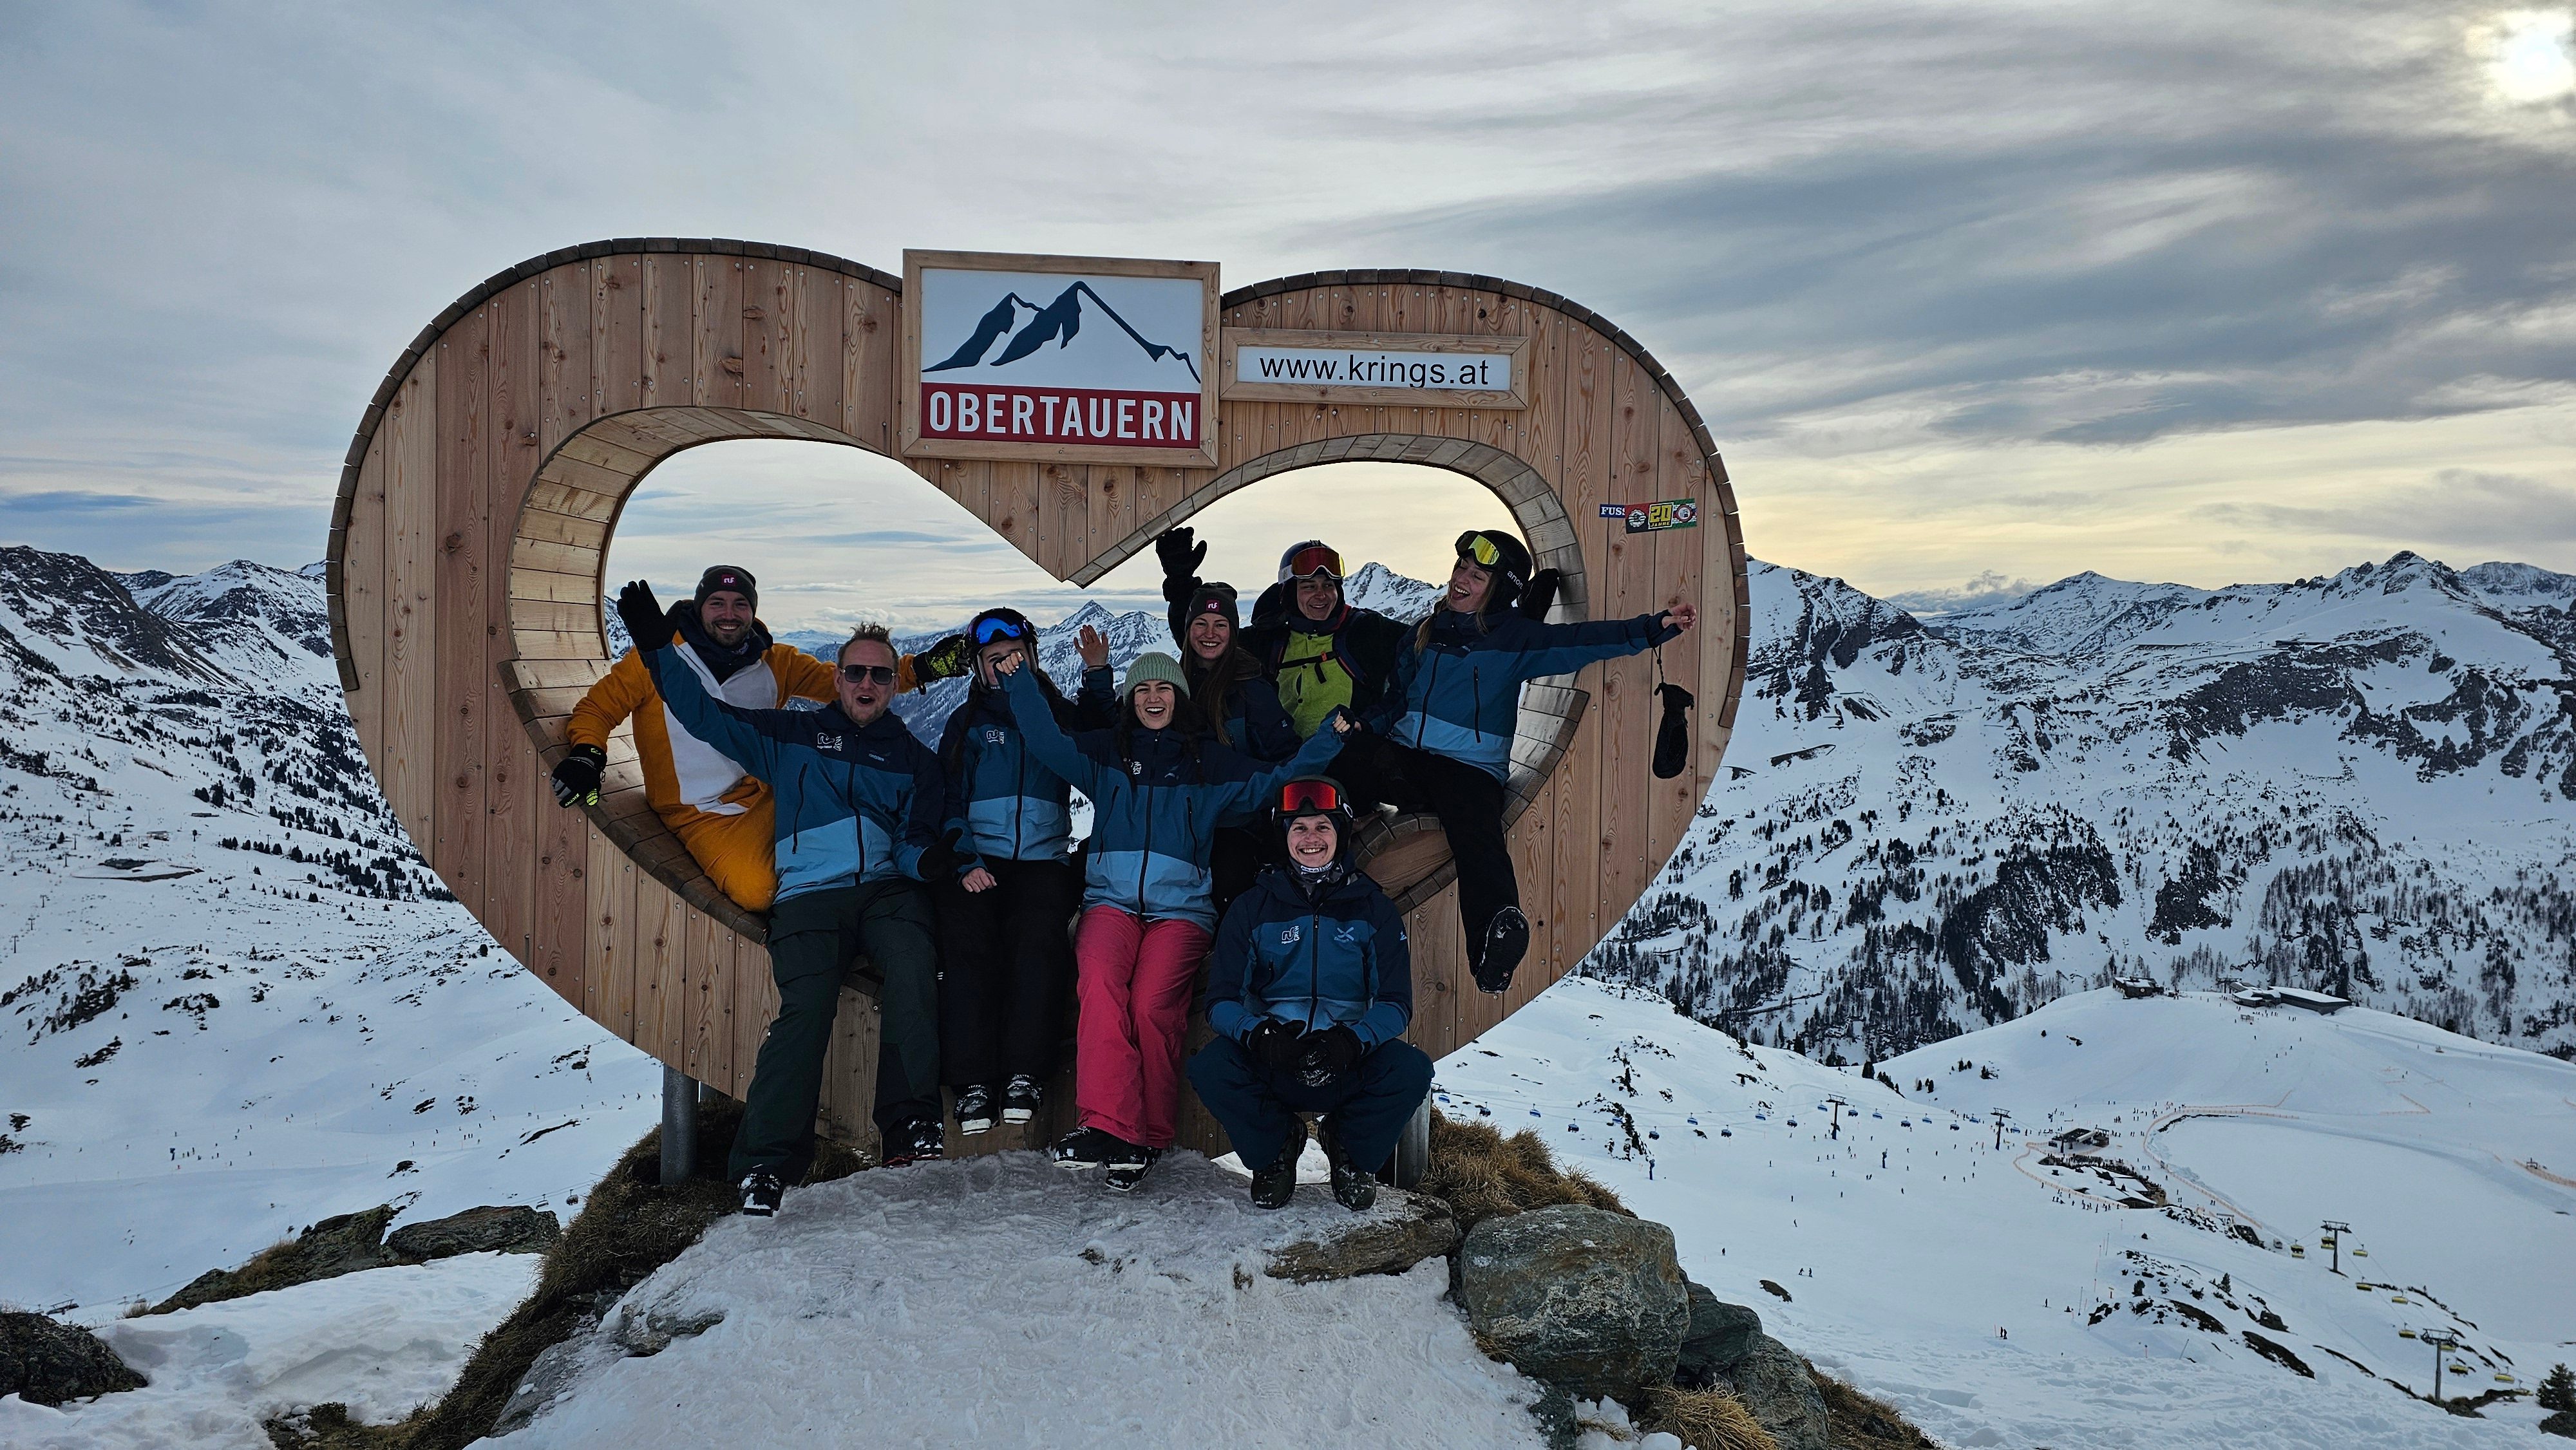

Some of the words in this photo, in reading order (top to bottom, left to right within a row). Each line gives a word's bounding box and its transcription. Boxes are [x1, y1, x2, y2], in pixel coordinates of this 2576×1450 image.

[1259, 355, 1489, 388] www.krings.at
[929, 391, 1193, 440] OBERTAUERN
[1650, 504, 1672, 523] 20
